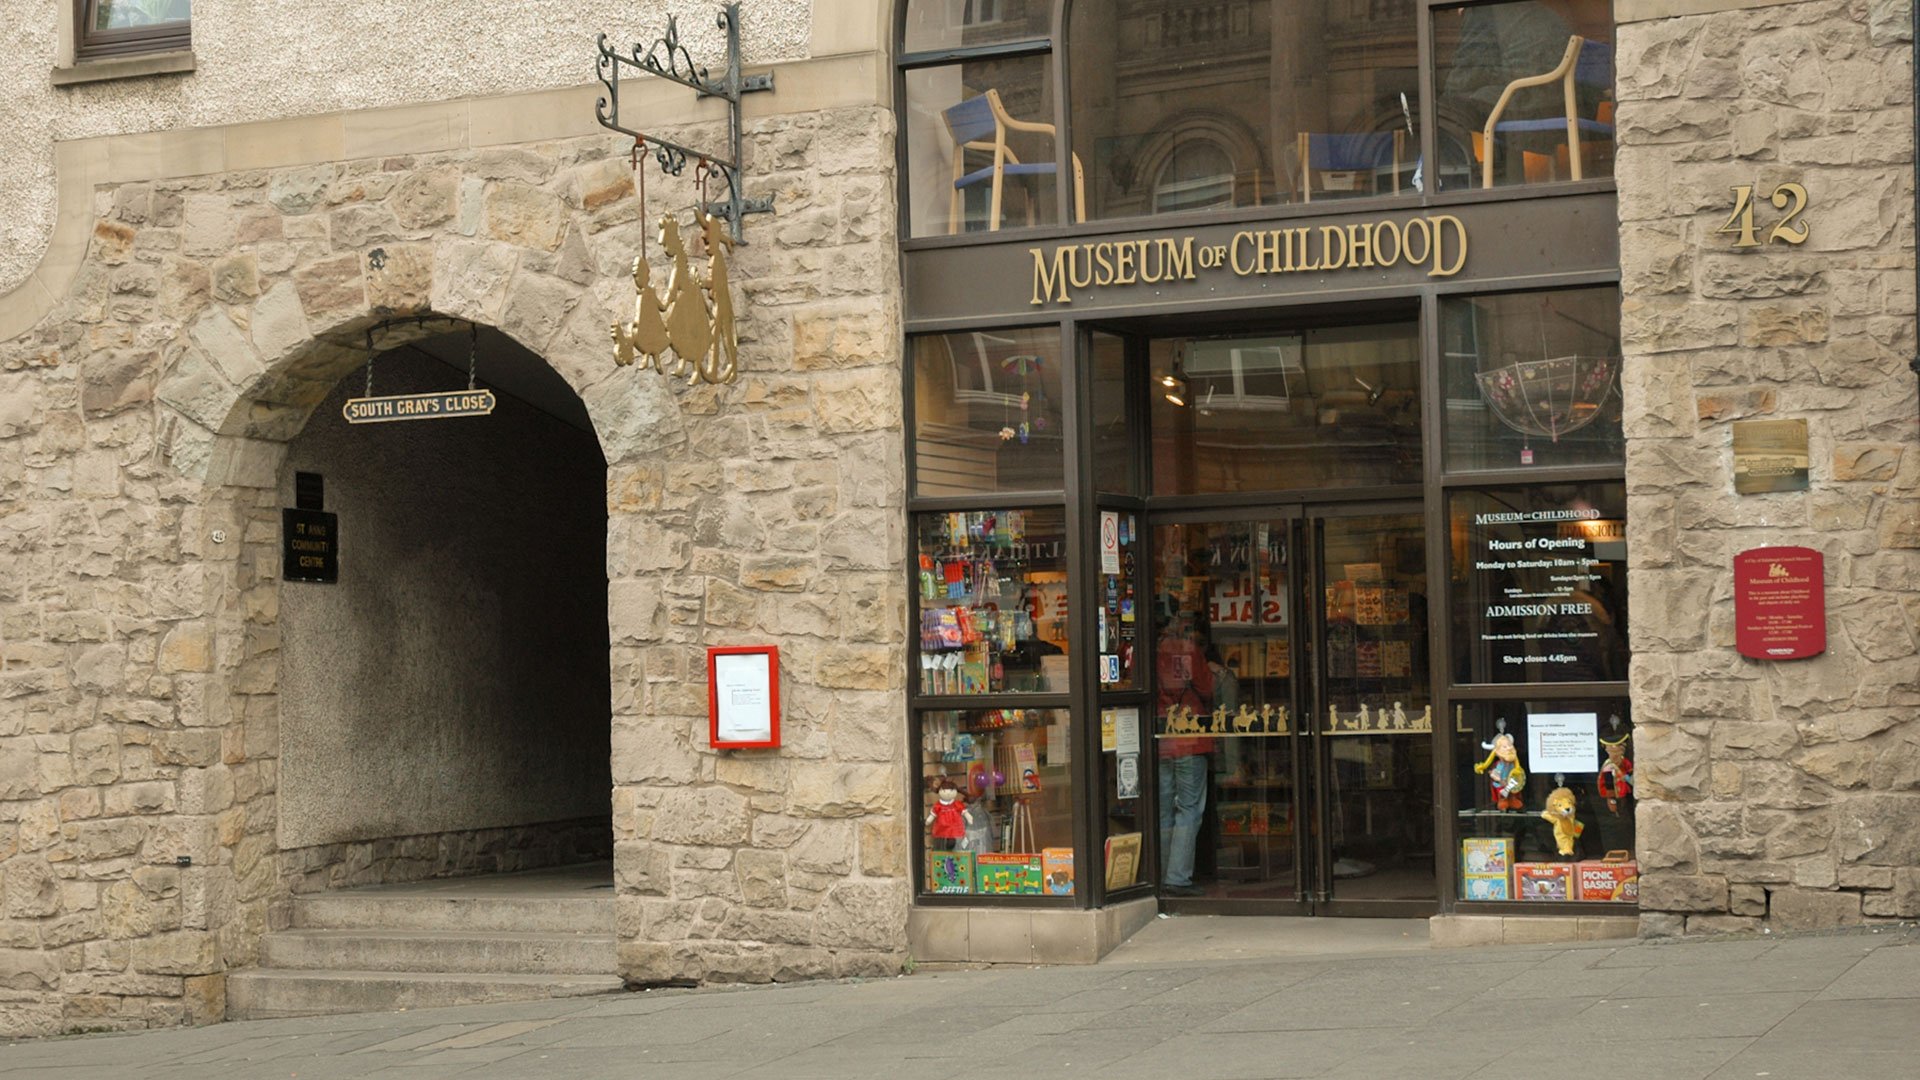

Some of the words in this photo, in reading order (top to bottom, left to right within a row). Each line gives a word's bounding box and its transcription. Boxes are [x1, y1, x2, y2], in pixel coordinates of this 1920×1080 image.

[1714, 182, 1811, 248] 42
[1029, 235, 1197, 305] MUSEUM
[1198, 245, 1229, 268] OF
[1230, 213, 1468, 277] CHILDHOOD
[351, 401, 393, 418] SOUTH
[397, 398, 440, 415] GRAY'S
[445, 394, 488, 411] CLOSE
[1475, 511, 1524, 525] MUSEUM
[1531, 508, 1601, 521] CHILDHOOD
[1488, 539, 1523, 551] Hours
[1525, 538, 1538, 549] of
[1538, 537, 1586, 551] Opening
[1476, 561, 1506, 571] Monday
[1507, 561, 1516, 569] to
[1554, 559, 1575, 567] 10am
[1581, 558, 1600, 568] 5pm
[1485, 604, 1557, 618] ADMISSION
[1560, 603, 1593, 615] FREE
[1503, 655, 1523, 665] Shop
[1524, 654, 1548, 663] closes
[1548, 653, 1578, 664] 4.45pm
[1582, 871, 1614, 881] PICNIC
[1582, 880, 1618, 890] BASKET
